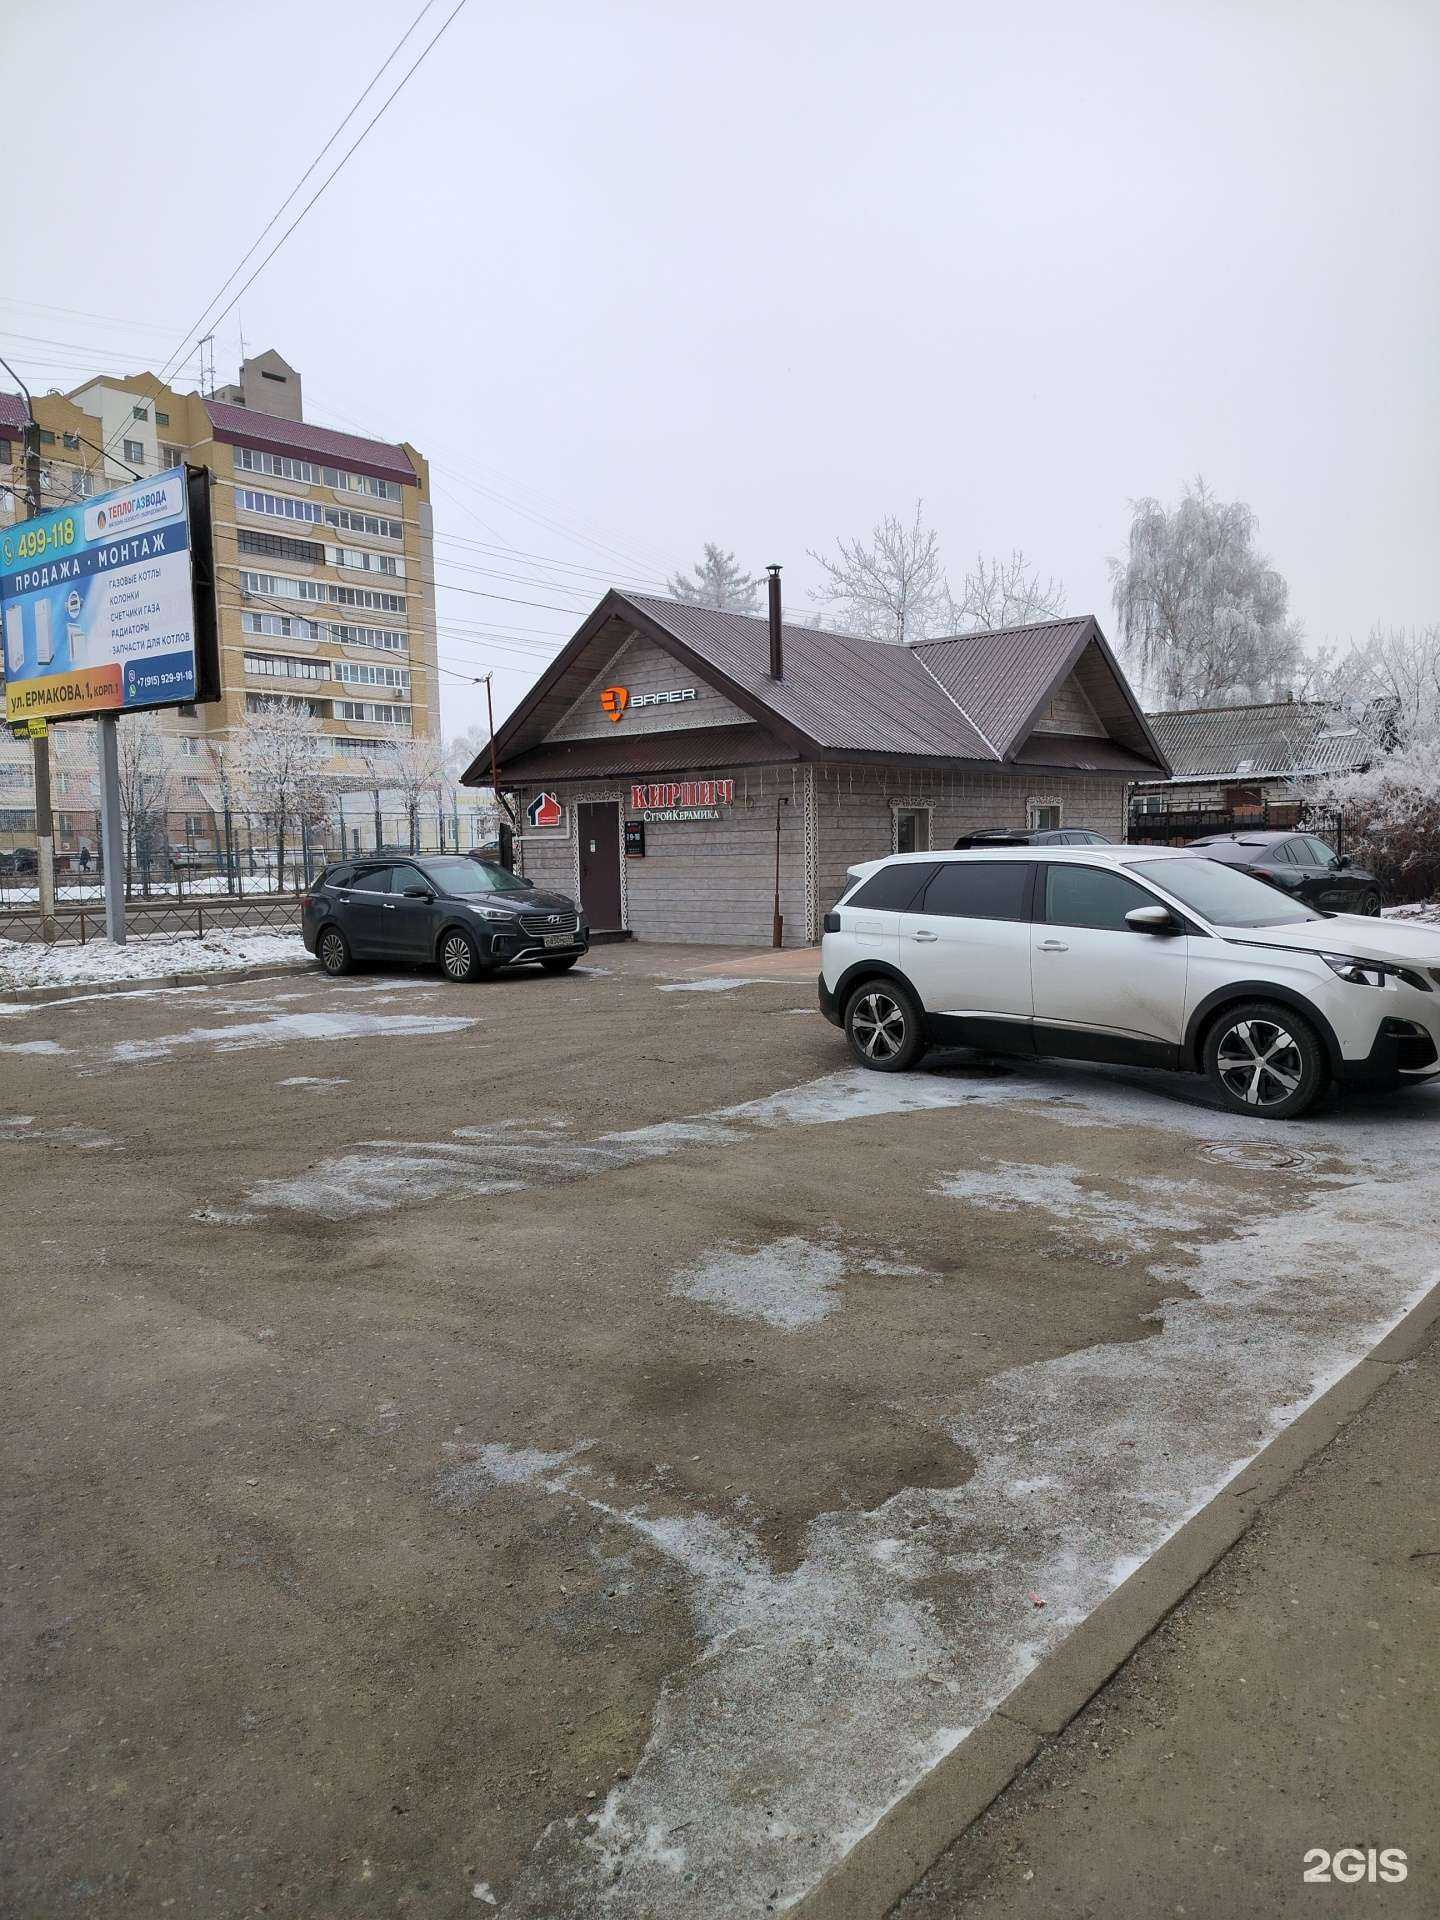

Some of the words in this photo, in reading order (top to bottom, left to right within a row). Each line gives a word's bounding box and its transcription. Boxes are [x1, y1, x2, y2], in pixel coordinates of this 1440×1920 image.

[108, 489, 167, 519] ТЕПЛОГАЗВОДА
[18, 518, 75, 559] 499-118
[15, 558, 81, 592] ПРОДАЖА
[98, 532, 166, 568] МОНТАЖ
[109, 574, 137, 589] ГАЗОВЫЕ
[138, 567, 161, 581] КОТЛЫ
[110, 590, 140, 606] КОЛОНКИ
[110, 607, 143, 622] СЧЕТЧИКИ
[144, 603, 161, 614] ГАЗА
[111, 622, 150, 638] РАДИАТОРЫ
[112, 640, 145, 655] ЗАПЧАСТИ
[147, 638, 161, 650] ДЛЯ
[162, 632, 190, 645] КОТЛОВ
[161, 670, 193, 685] 929-91-18
[11, 697, 25, 713] ул.
[25, 686, 85, 707] ЕРМАКОВА,
[630, 688, 696, 707] BRAER
[631, 779, 734, 809] КИРПИЧ
